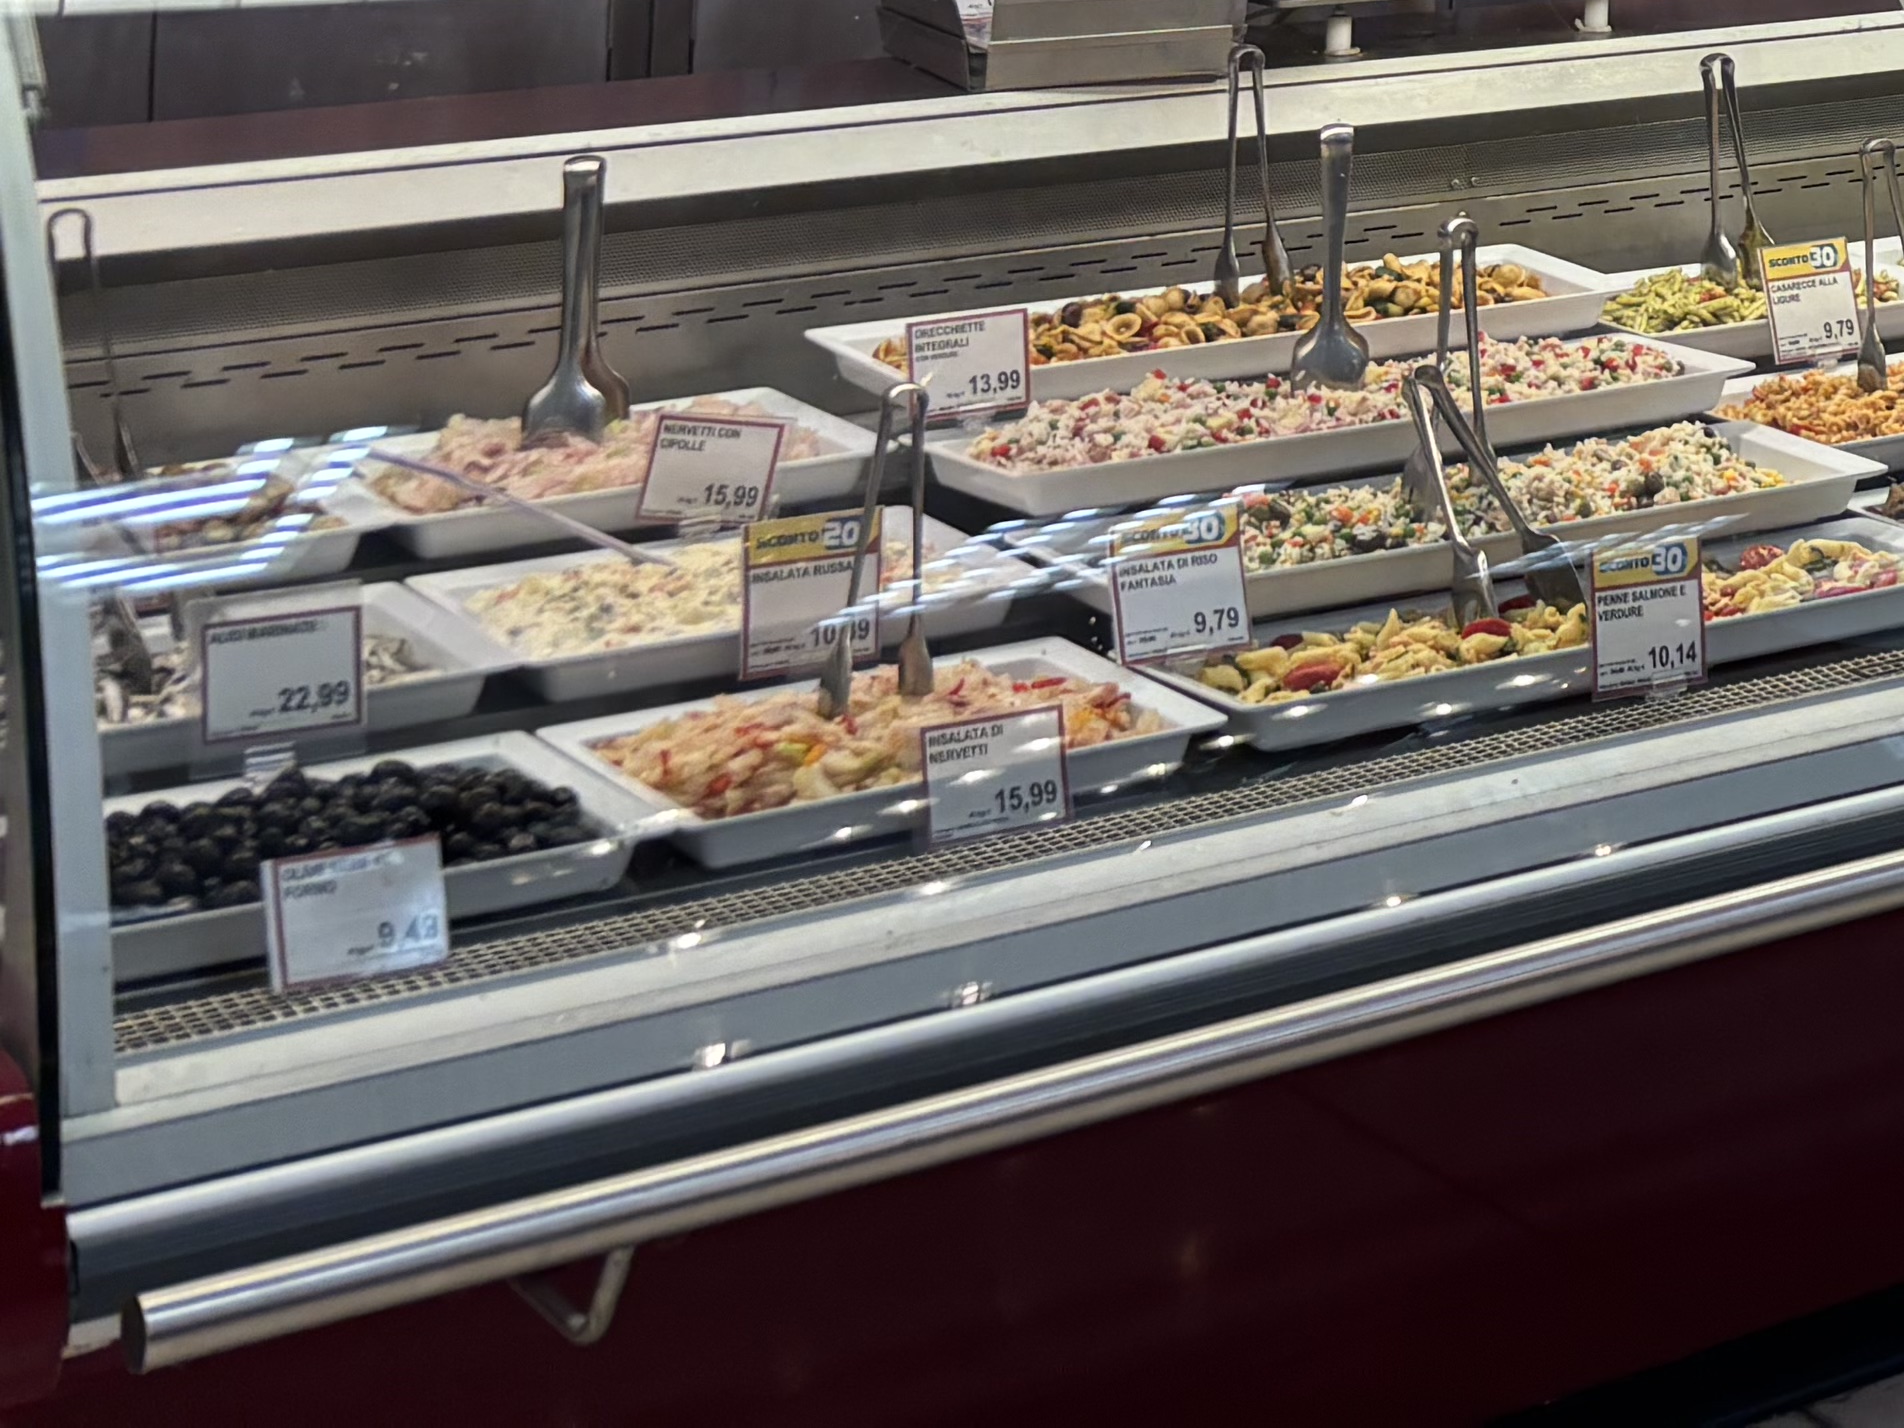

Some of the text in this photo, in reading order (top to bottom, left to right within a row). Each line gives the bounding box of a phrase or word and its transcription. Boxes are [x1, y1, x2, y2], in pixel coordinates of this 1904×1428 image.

[1769, 244, 1838, 269] SCONTO 30
[1770, 276, 1839, 295] CASARECCE ALLA
[1773, 293, 1801, 306] LIGURE
[914, 321, 986, 340] ORECCHIETTE
[1823, 318, 1855, 341] 9,79
[914, 337, 970, 354] INTEGRALI
[969, 369, 1021, 396] 13,99
[663, 423, 742, 440] NERVETTI CON
[660, 437, 706, 453] CIPOLLE
[703, 483, 759, 508] 15,99
[1183, 512, 1226, 544] 30
[1119, 552, 1218, 577] INSALATA DI RISO
[1652, 545, 1688, 574] 30
[752, 561, 854, 585] INSALATA RUSSA
[1120, 575, 1177, 592] FANTASIA
[1598, 585, 1686, 605] PENNE SALMONE E
[1194, 606, 1239, 636] 9,79
[1598, 604, 1645, 623] VERDURE
[1648, 640, 1697, 671] 10,14
[278, 679, 351, 717] 22,99
[928, 723, 1004, 748] INSALATA DI
[928, 743, 988, 764] NERVETTI
[994, 780, 1058, 814] 15,99
